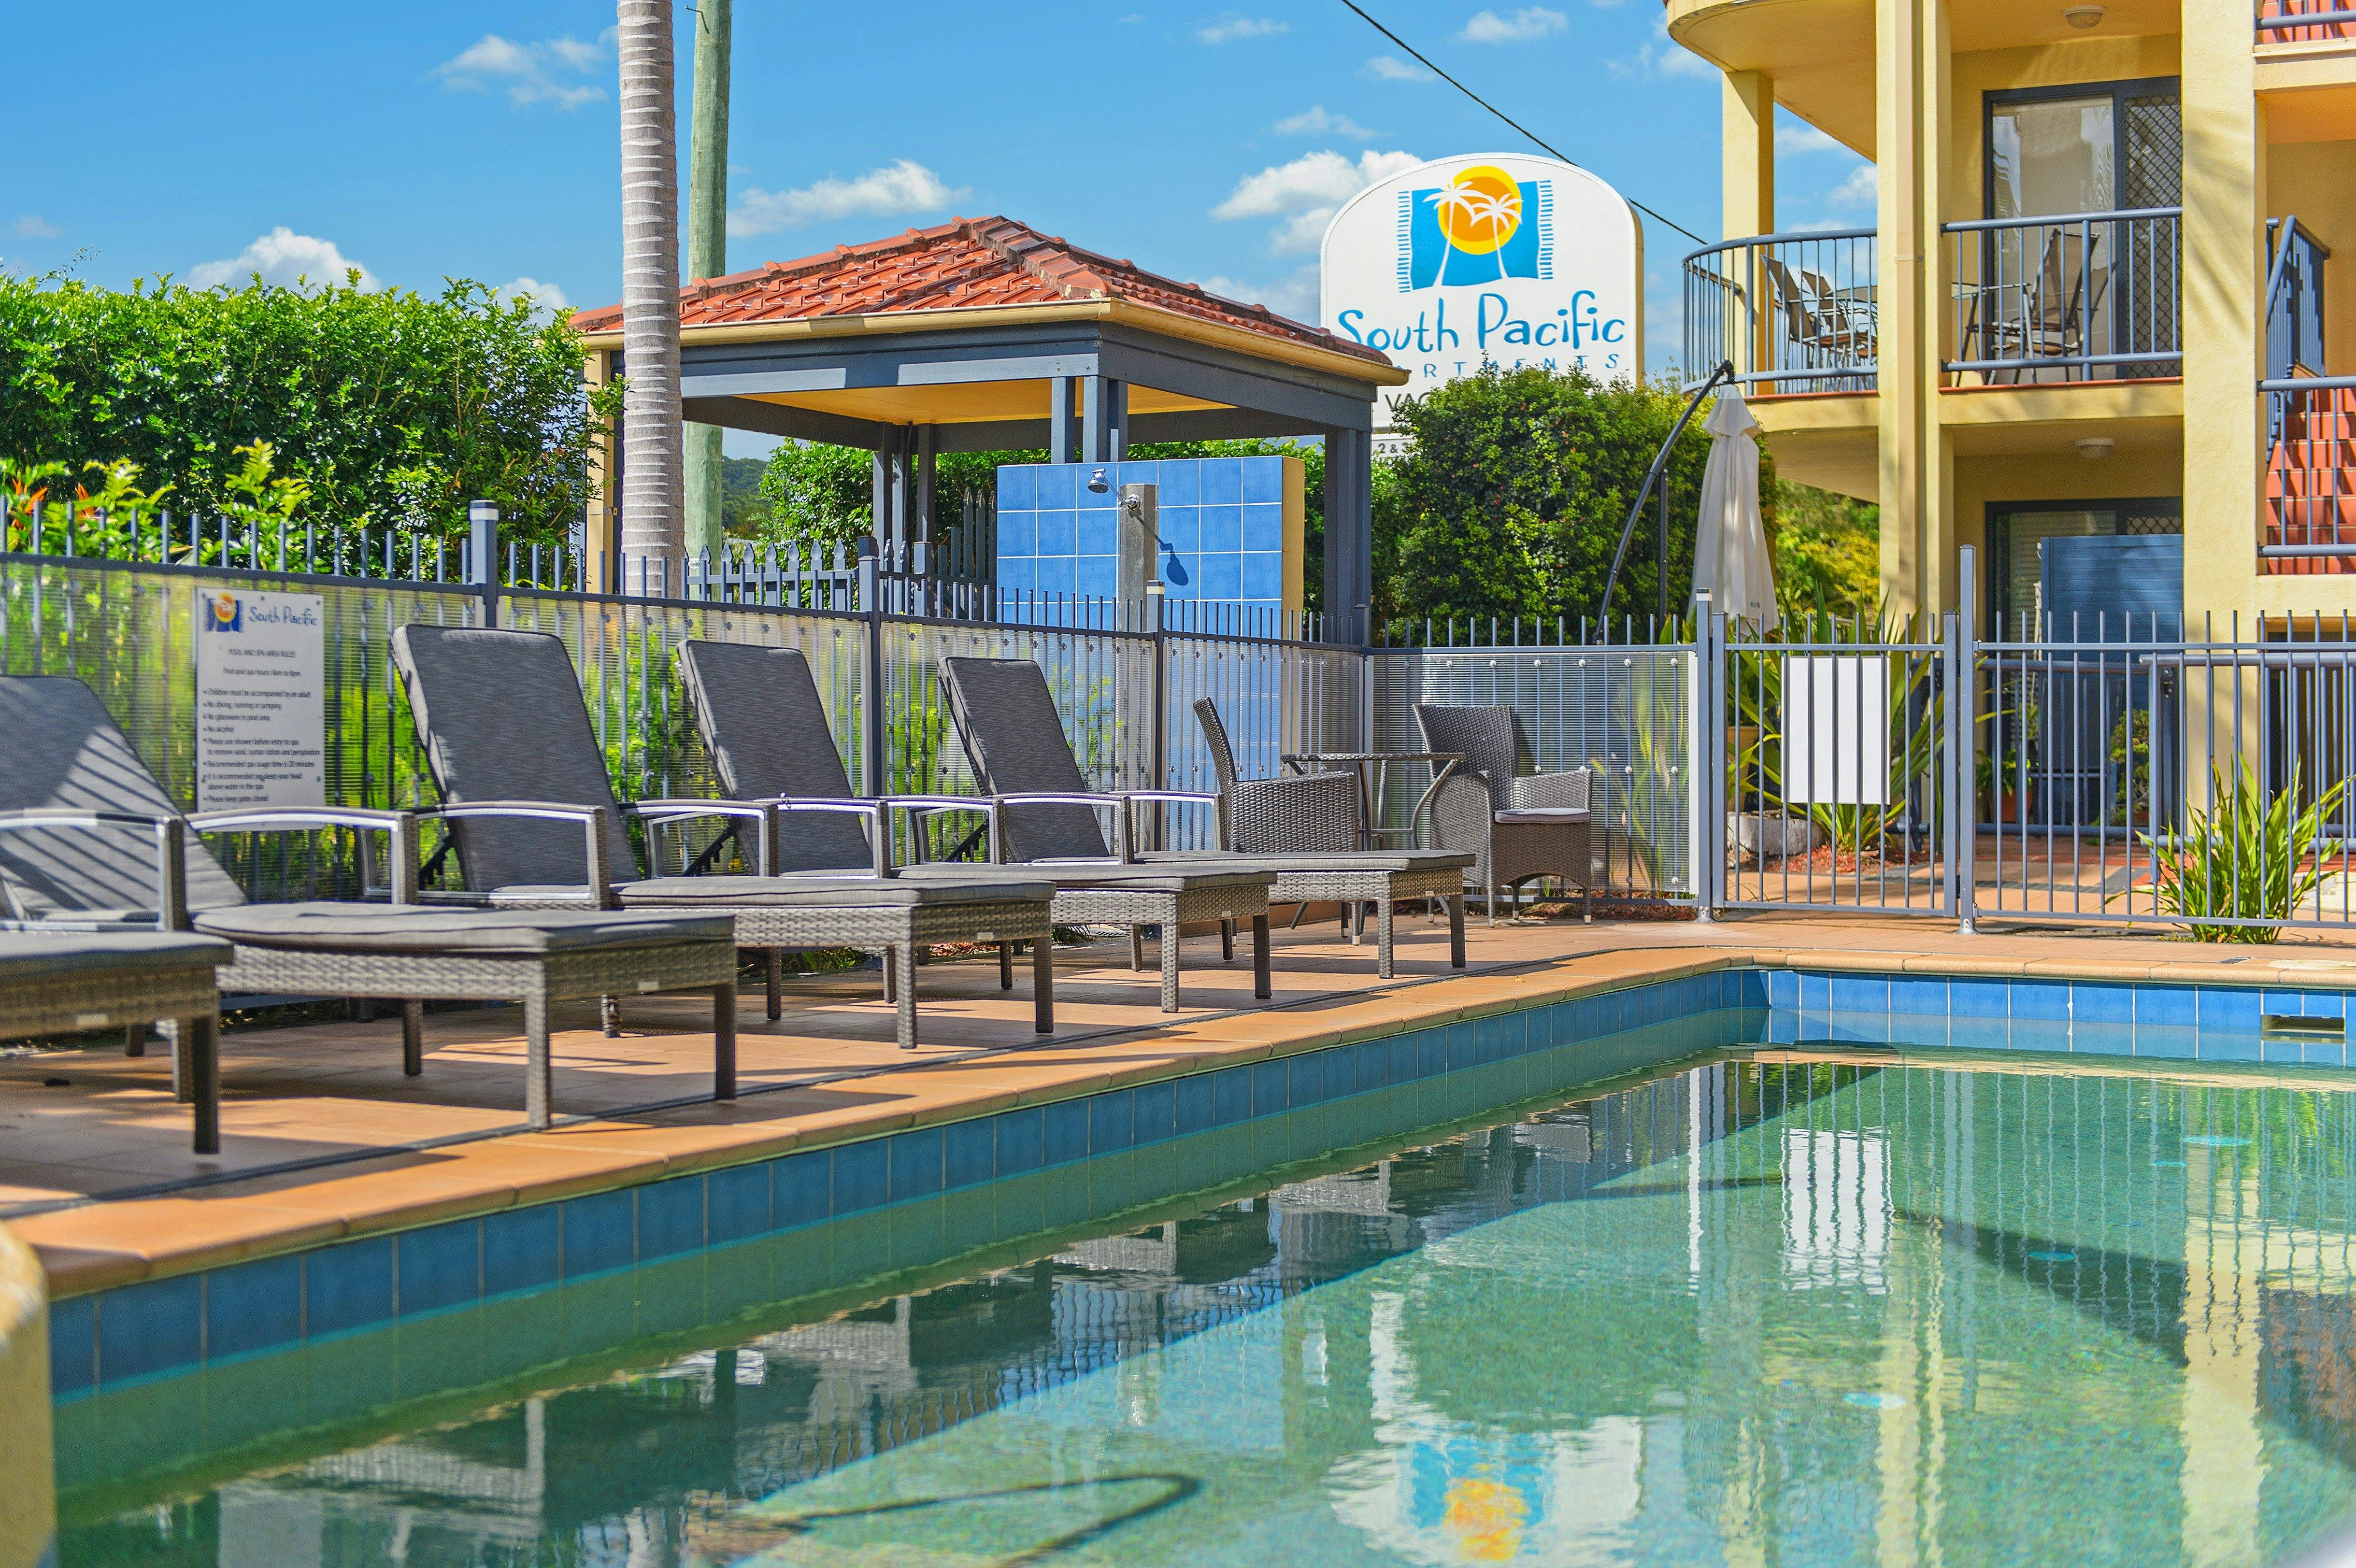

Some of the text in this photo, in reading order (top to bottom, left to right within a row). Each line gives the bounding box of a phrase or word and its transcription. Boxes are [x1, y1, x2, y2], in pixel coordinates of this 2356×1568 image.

[1338, 289, 1625, 353] South Pacific
[1396, 353, 1620, 378] RTMENTS
[248, 605, 319, 627] South Pacific
